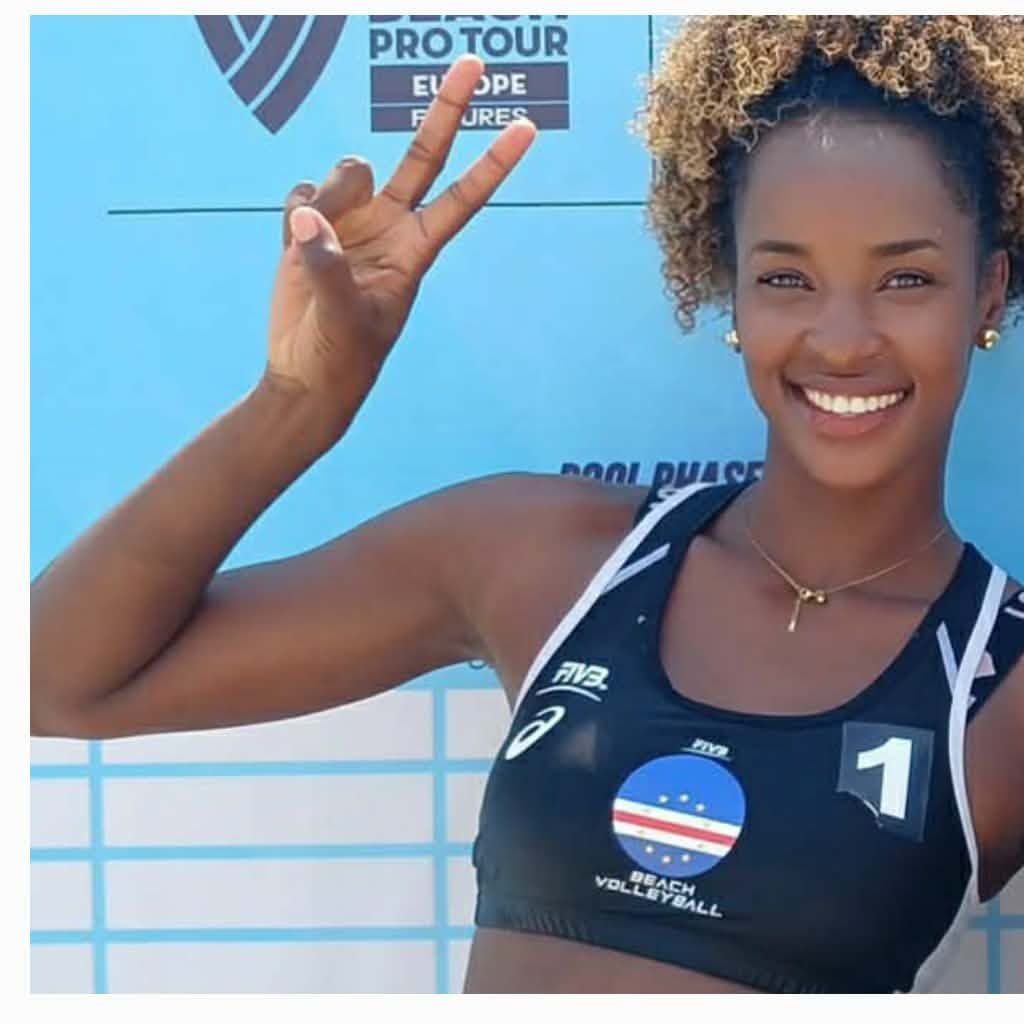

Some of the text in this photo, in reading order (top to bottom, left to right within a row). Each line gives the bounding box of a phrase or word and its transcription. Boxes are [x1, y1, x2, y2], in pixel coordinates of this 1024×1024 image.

[370, 26, 569, 60] PRO TOUR
[412, 73, 527, 97] EUOPE
[411, 106, 529, 128] FURES
[551, 661, 609, 689] FIVB
[856, 736, 914, 821] 1
[595, 875, 724, 918] VOLLEYBALL
[629, 870, 697, 896] BEACH
